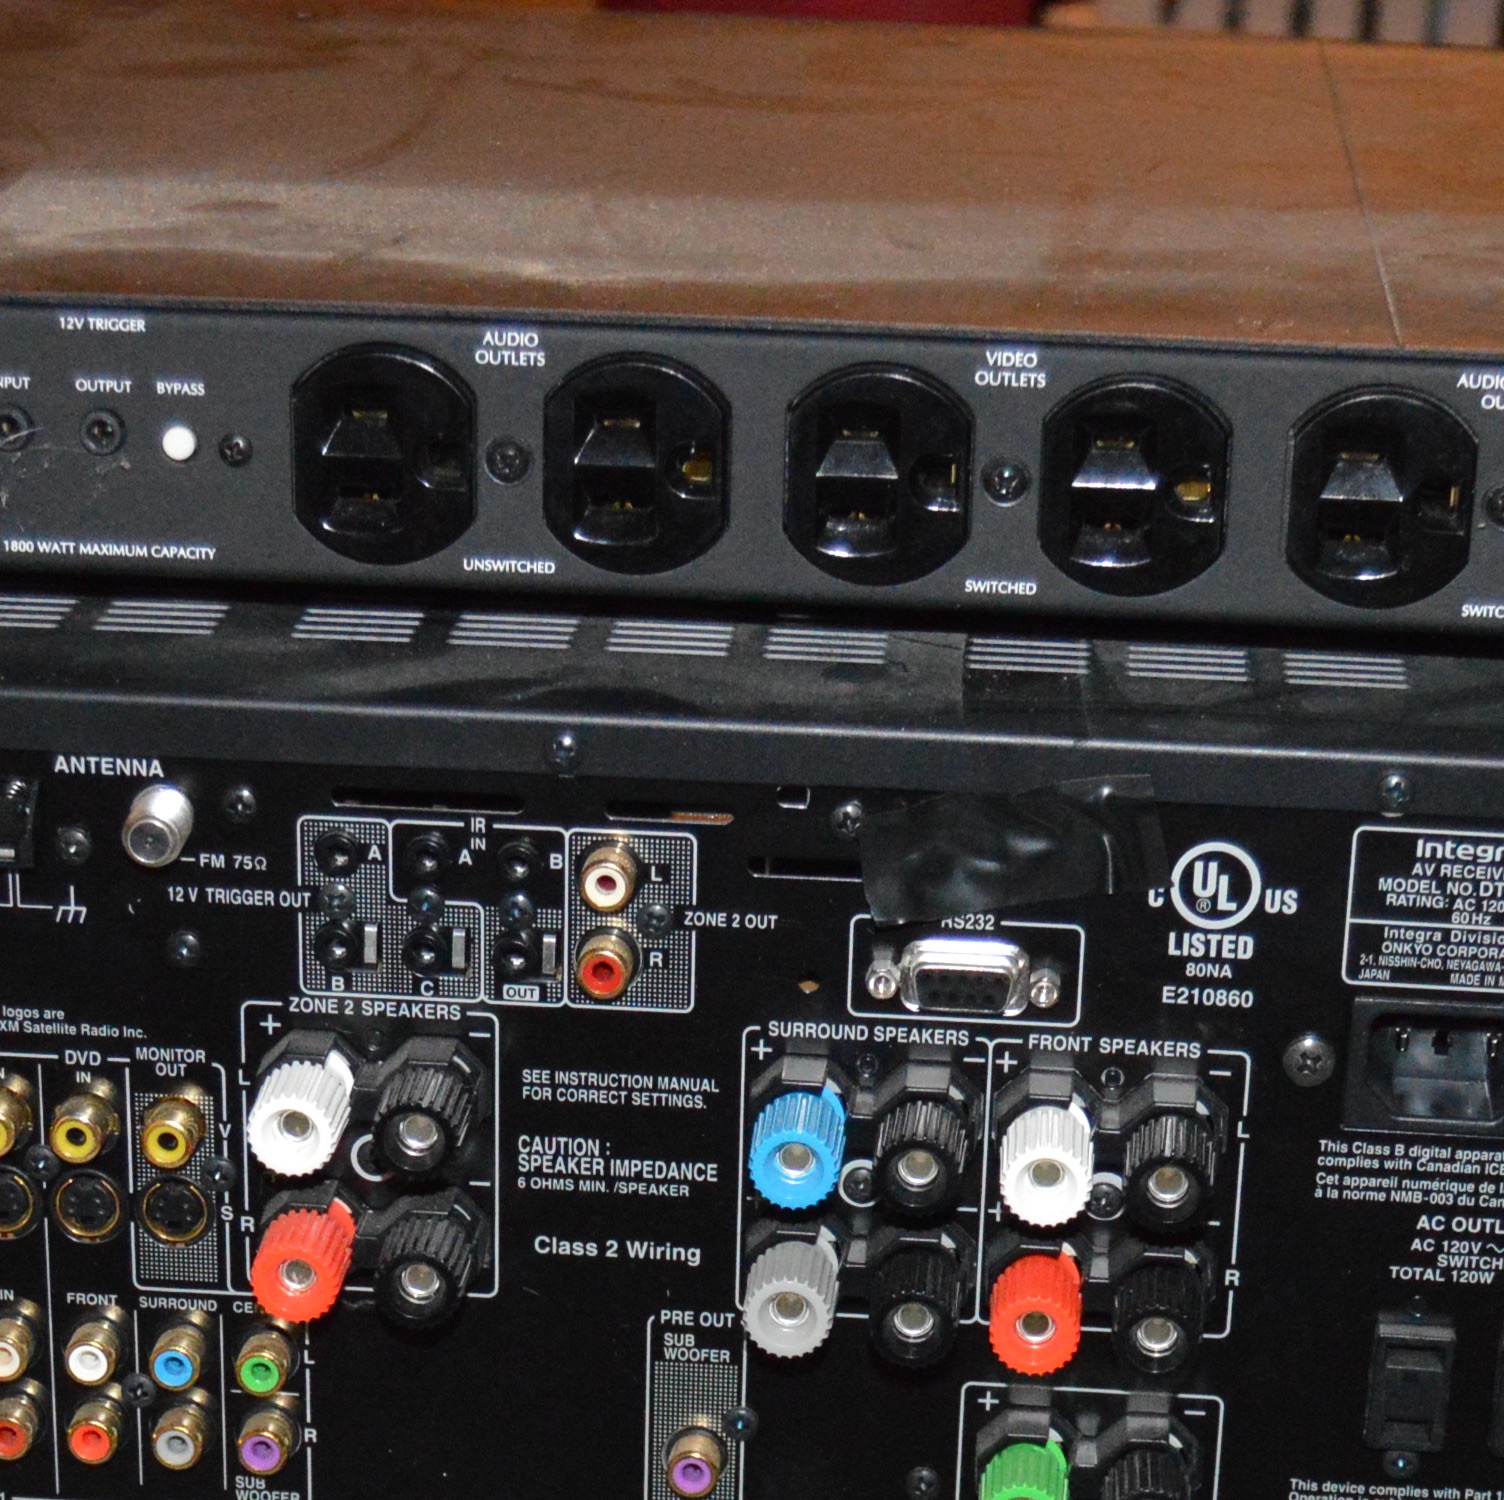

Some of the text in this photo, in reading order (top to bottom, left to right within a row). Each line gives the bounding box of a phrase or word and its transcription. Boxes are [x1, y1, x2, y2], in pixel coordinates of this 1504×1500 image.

[58, 315, 145, 332] 12V TRIGGER
[482, 331, 538, 348] AUDIO
[474, 348, 545, 367] OUTLETS
[985, 350, 1038, 368] VIDEO
[74, 377, 132, 393] OUTPUT
[155, 380, 205, 396] BYPASS
[974, 369, 1046, 388] OUTLETS
[2, 539, 216, 560] 1800 WATT MAXIMUM CAPACITY
[462, 557, 555, 574] UNSWITCHED
[964, 578, 1037, 595] SWITCHED
[54, 754, 164, 778] ANTENNA
[1411, 862, 1436, 877] AV
[1377, 876, 1441, 896] MODEL
[167, 885, 311, 908] 12 V TRIGGER OUT
[1264, 888, 1298, 915] US
[1385, 893, 1449, 910] RATING:
[1452, 900, 1476, 912] AC
[683, 910, 778, 929] ZONE 2 OUT
[1167, 931, 1254, 959] LISTED
[1383, 925, 1445, 946] Integra
[1381, 940, 1433, 958] ONKYO
[1185, 961, 1232, 978] 80NA
[1161, 985, 1253, 1008] E210860
[1, 1004, 39, 1020] logos
[42, 1009, 64, 1020] are
[288, 996, 461, 1021] ZONE 2 SPEAKERS
[22, 1020, 77, 1035] Satellite
[80, 1022, 119, 1037] Radio
[122, 1025, 146, 1038] Inc.
[768, 1019, 969, 1046] SURROUND SPEAKERS
[135, 1046, 205, 1064] MONITOR
[1028, 1033, 1201, 1059] FRONT SPEAKERS
[64, 1049, 101, 1066] DVD
[154, 1061, 187, 1077] OUT
[522, 1068, 719, 1093] SEE INSTRUCTION MANUAL
[522, 1085, 706, 1109] FOR CORRECT SETTINGS.
[517, 1134, 600, 1160] CAUTION
[1318, 1138, 1348, 1153] This
[1351, 1140, 1390, 1157] Class
[1393, 1143, 1405, 1159] B
[1407, 1144, 1451, 1160] digital
[517, 1153, 718, 1182] SPEAKER IMPEDANCE
[1415, 1214, 1445, 1231] AC
[533, 1234, 700, 1266] Class 2 Wiring
[66, 1291, 119, 1308] FRONT
[138, 1295, 217, 1313] SURROUND
[660, 1308, 735, 1328] PRE OUT
[663, 1331, 696, 1350] SUB
[663, 1346, 730, 1363] WOOFER
